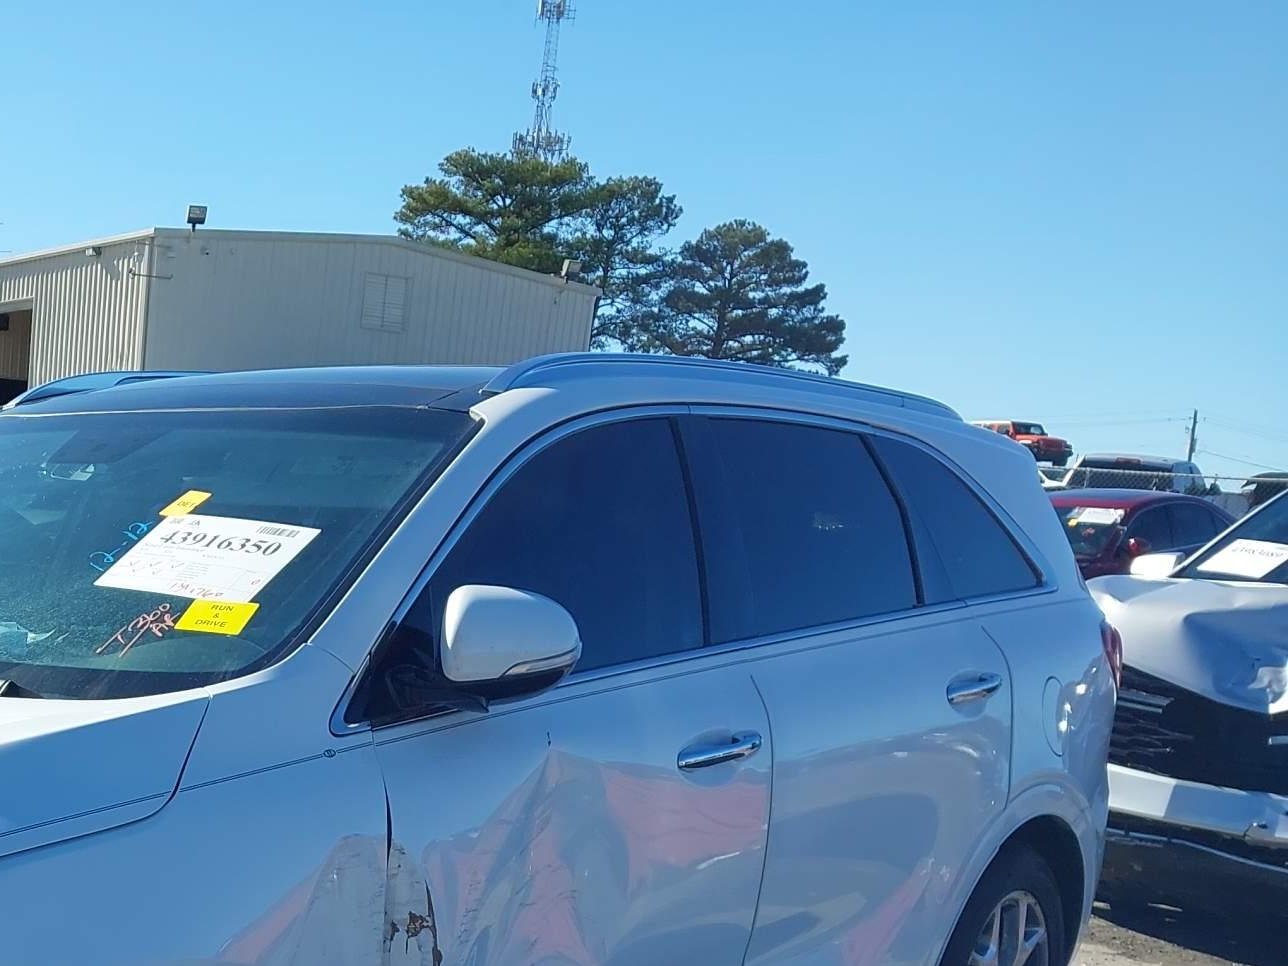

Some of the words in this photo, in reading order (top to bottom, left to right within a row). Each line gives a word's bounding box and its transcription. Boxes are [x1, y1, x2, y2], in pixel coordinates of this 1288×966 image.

[160, 530, 282, 556] 43916350
[210, 604, 234, 612] RUN
[195, 619, 229, 628] DRIVE
